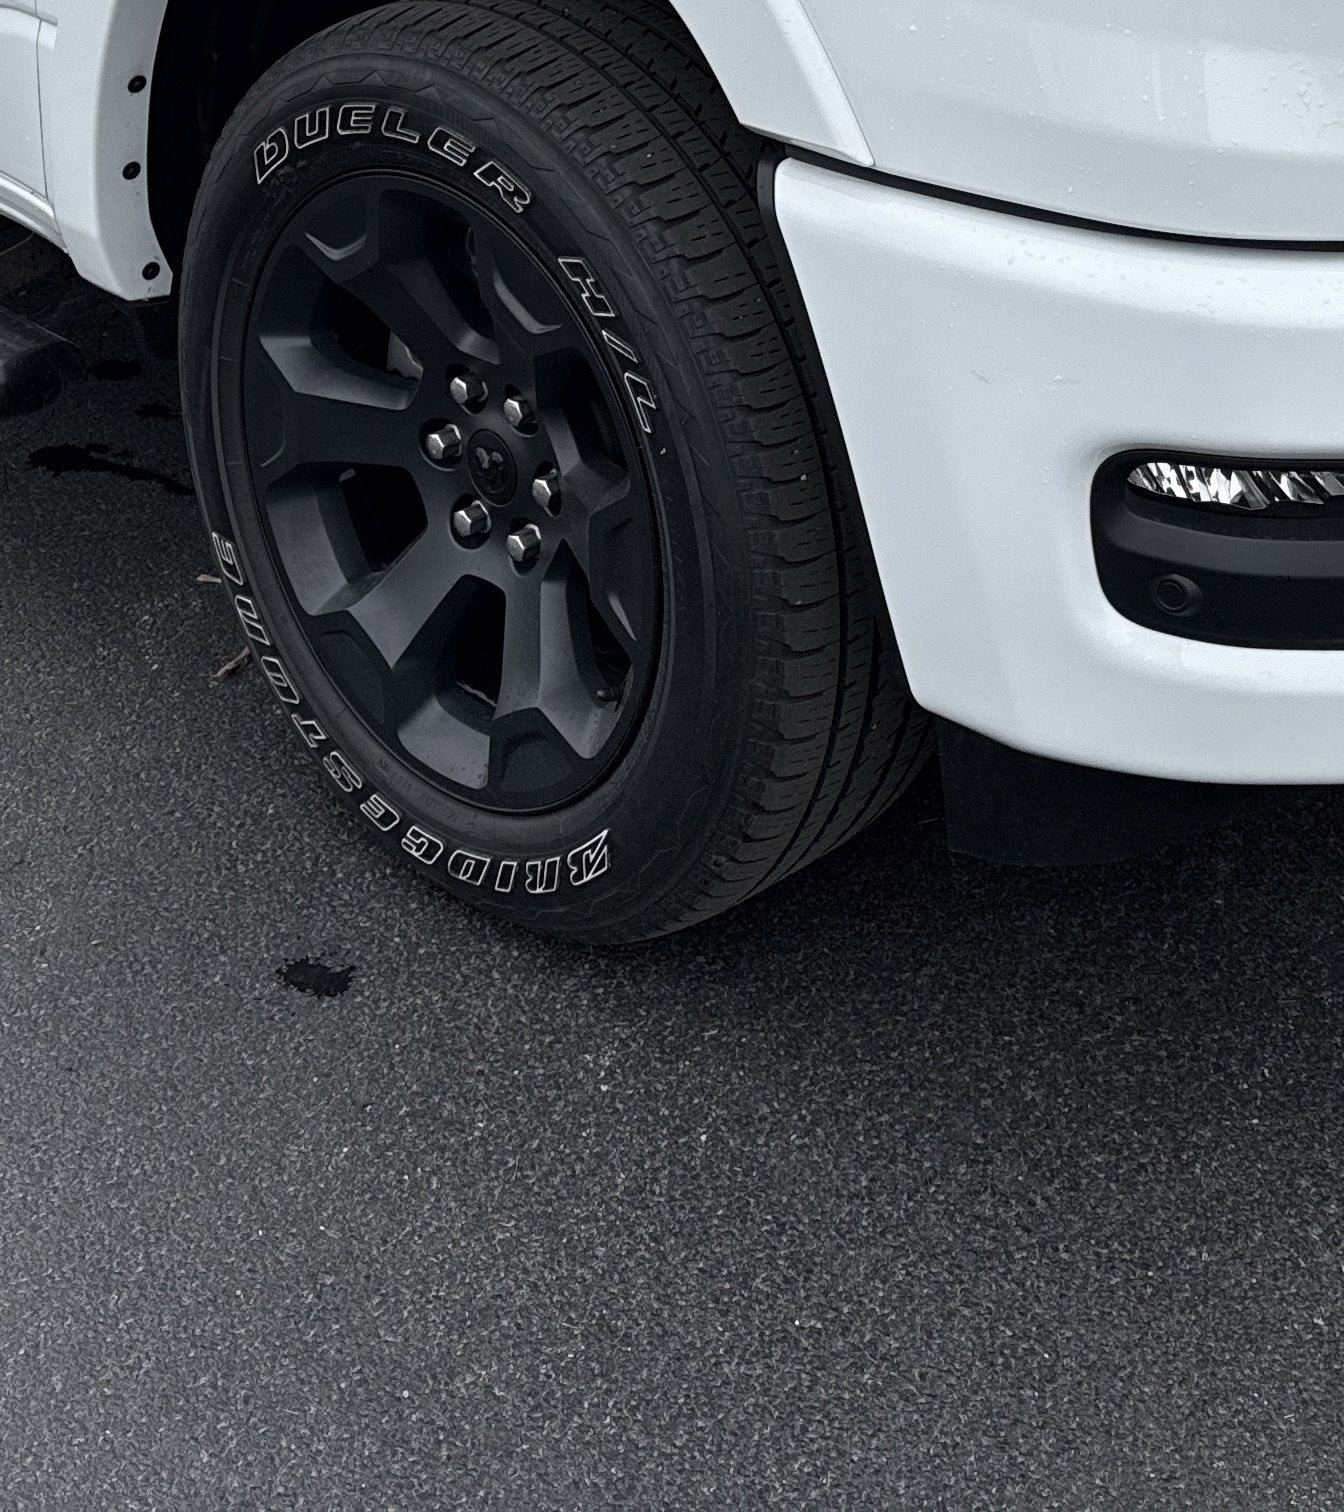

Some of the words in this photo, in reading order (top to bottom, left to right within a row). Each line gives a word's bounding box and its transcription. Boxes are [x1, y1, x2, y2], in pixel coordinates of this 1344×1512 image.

[253, 103, 532, 214] DUELER
[557, 256, 657, 434] H/L
[211, 531, 611, 894] BRIDGESTONE
